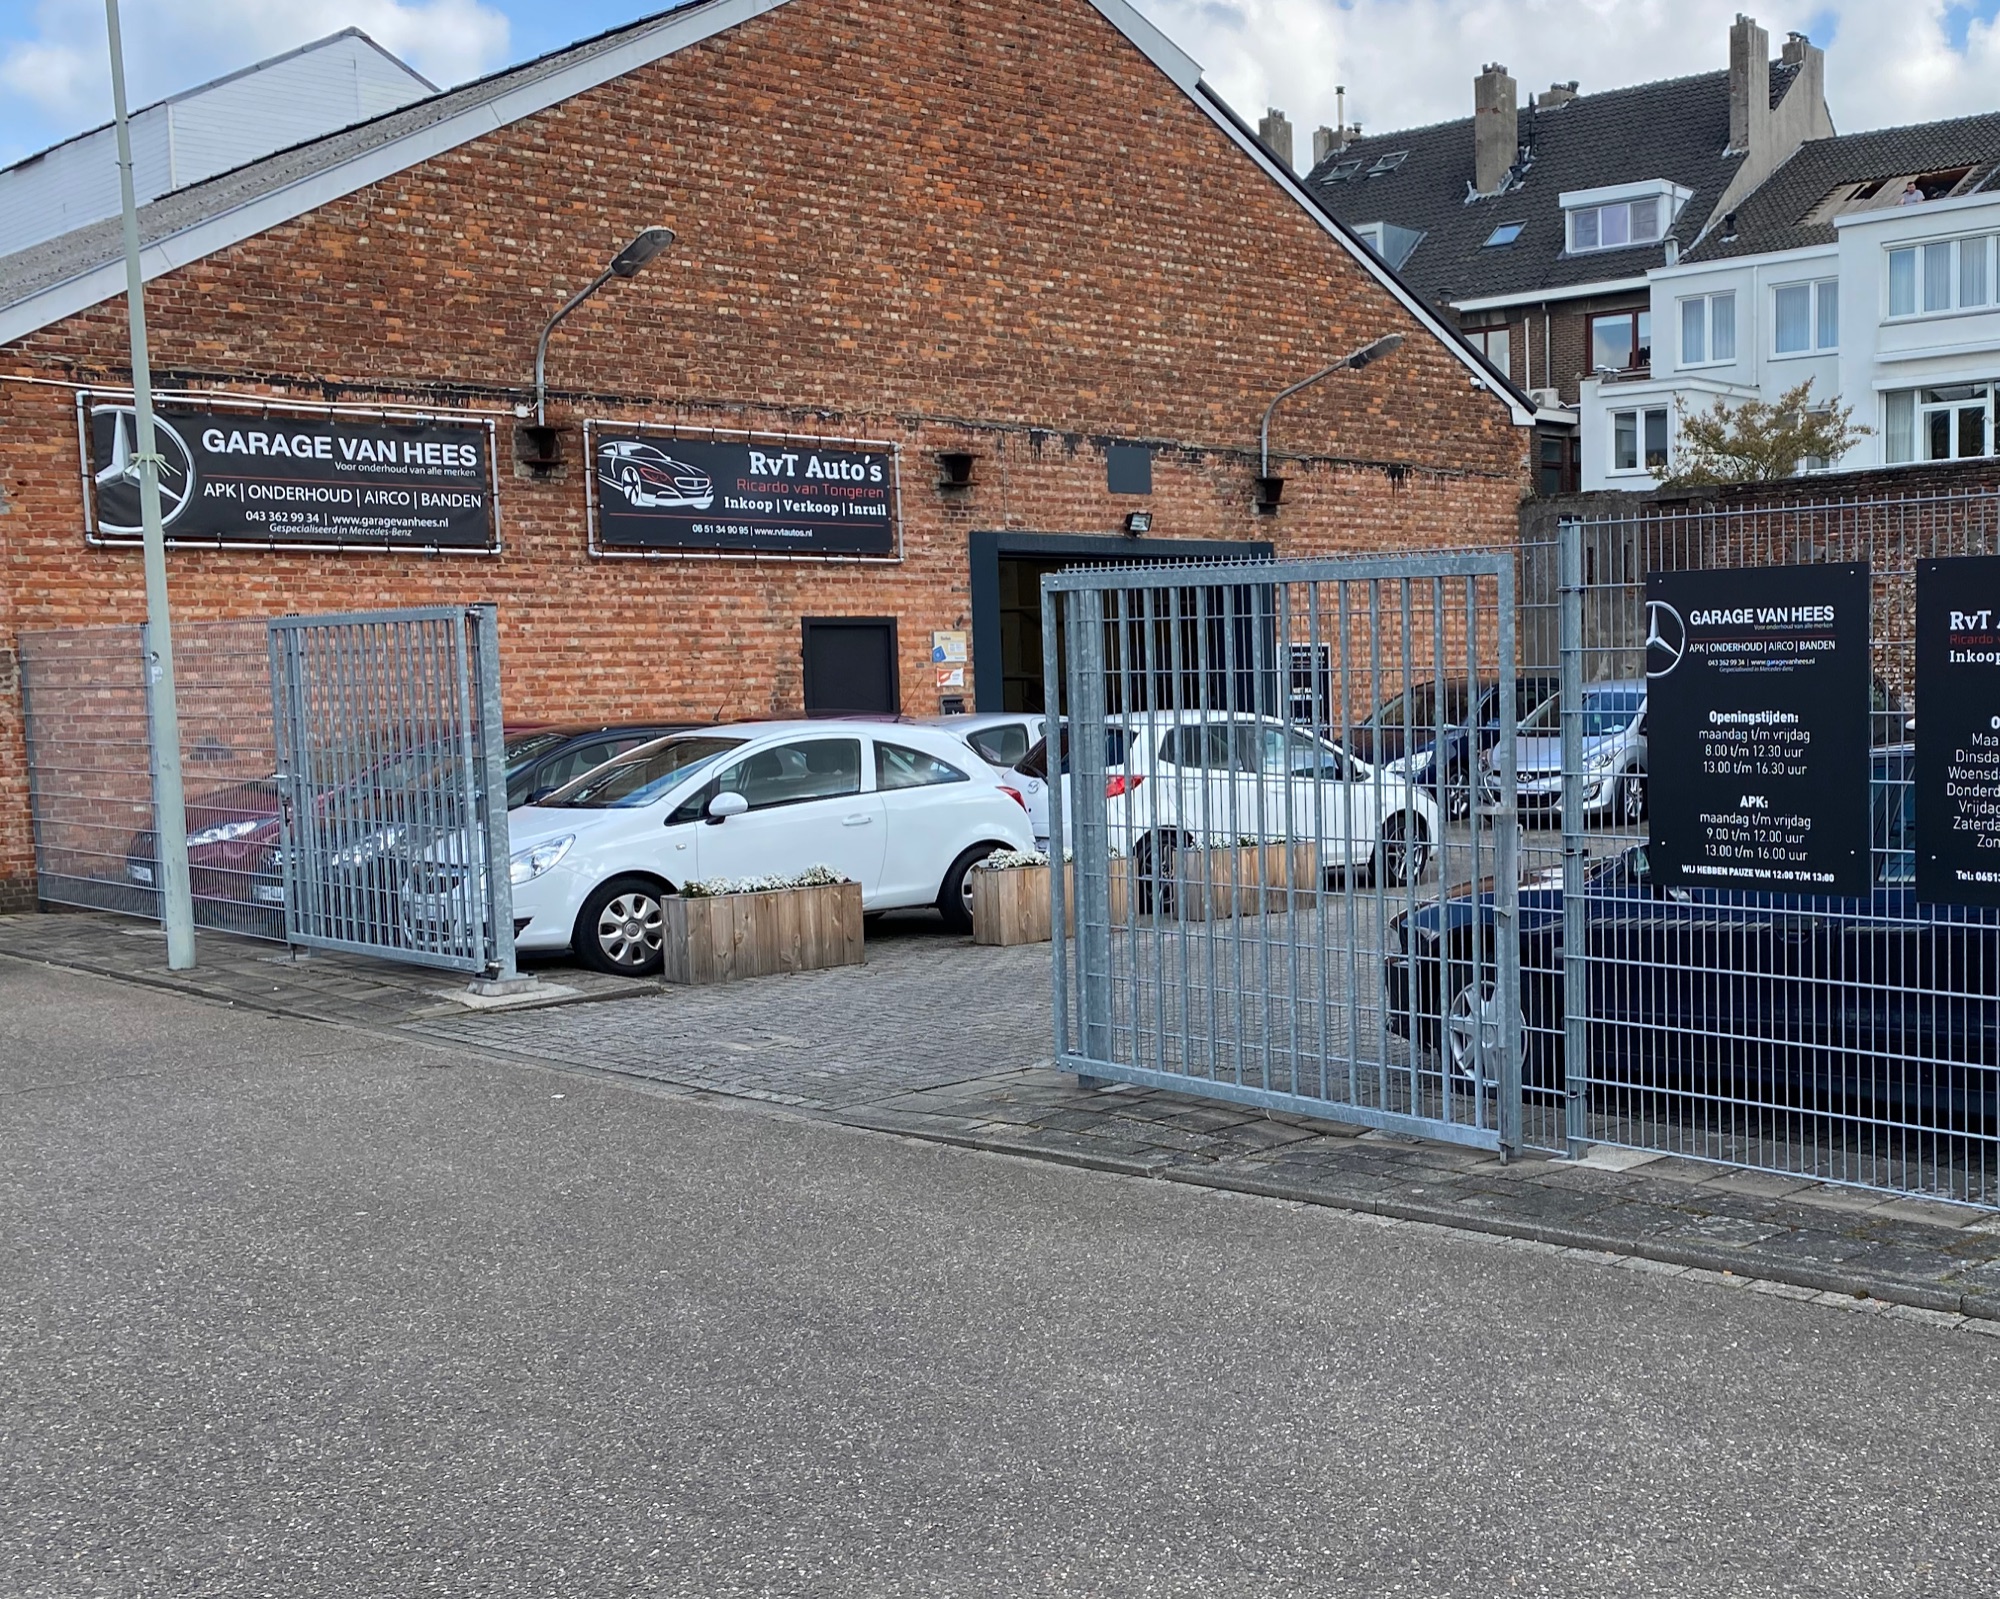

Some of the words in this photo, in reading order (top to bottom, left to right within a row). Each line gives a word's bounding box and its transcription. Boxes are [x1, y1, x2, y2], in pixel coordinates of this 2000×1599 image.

[202, 429, 333, 459] GARAGE
[338, 437, 397, 462] VAN
[403, 441, 478, 467] HEES
[335, 462, 357, 471] Voor
[358, 463, 408, 474] onderhoud
[427, 467, 442, 476] alle
[443, 469, 477, 477] merken
[749, 451, 798, 476] RvT
[805, 454, 883, 482] Auto's
[203, 482, 237, 498] APK
[248, 485, 353, 503] ONDERHOUD
[364, 491, 410, 506] AIRCO
[421, 493, 482, 508] BANDEN
[737, 478, 789, 494] Ricardo
[793, 484, 819, 495] van
[822, 483, 884, 499] Tongeren
[724, 496, 773, 513] Inkoop
[784, 500, 839, 516] Verkoop
[849, 503, 887, 516] Inruil
[245, 510, 266, 521] 043
[268, 511, 289, 522] 362
[290, 512, 304, 522] 99
[306, 513, 320, 523] 34
[332, 515, 449, 528] www.garagevanhees.nl
[269, 523, 337, 535] Gespecialiseerd
[339, 525, 347, 534] in
[349, 527, 412, 537] Mercedes-Benz
[715, 525, 726, 534] 34
[1690, 609, 1754, 625] GARAGE
[1756, 607, 1788, 623] VAN
[1791, 605, 1835, 622] HEES
[1950, 610, 1992, 631] RvT
[1689, 643, 1705, 653] APK
[1710, 641, 1763, 653] ONDERHOUD
[1768, 641, 1794, 651] AIRCO
[1799, 640, 1836, 651] BANDEN
[1949, 634, 1994, 645] Ricardo
[1709, 710, 1800, 726] Openingstijden:
[1698, 728, 1748, 742] maandag
[1750, 728, 1770, 741] t/m
[1772, 729, 1811, 744] vrijdag
[1705, 745, 1728, 757] 8.00
[1729, 745, 1750, 758] t/m
[1753, 745, 1781, 758] 12.30
[1783, 748, 1804, 758] uur
[1703, 761, 1731, 774] 13.00
[1733, 761, 1754, 774] t/m
[1756, 762, 1785, 775] 16.30
[1787, 765, 1808, 775] uur
[1740, 795, 1769, 808] APK:
[1699, 812, 1750, 828] maandag
[1752, 813, 1771, 826] t/m
[1774, 814, 1811, 829] vrijdag
[1706, 828, 1728, 840] 9.00
[1731, 829, 1751, 841] t/m
[1753, 830, 1782, 843] 12.00
[1784, 834, 1805, 844] uur
[1705, 844, 1732, 857] 13.00
[1734, 845, 1754, 858] t/m
[1757, 846, 1786, 860] 16.00
[1788, 850, 1809, 861] uur
[1682, 864, 1696, 873] WIJ
[1696, 865, 1728, 877] HEBBEN
[1729, 867, 1754, 878] PAUZE
[1754, 869, 1771, 879] VAN
[1772, 870, 1794, 881] 12:00
[1795, 870, 1811, 882] T/M
[1812, 872, 1835, 883] 13:00
[1955, 870, 1974, 881] Tel:
